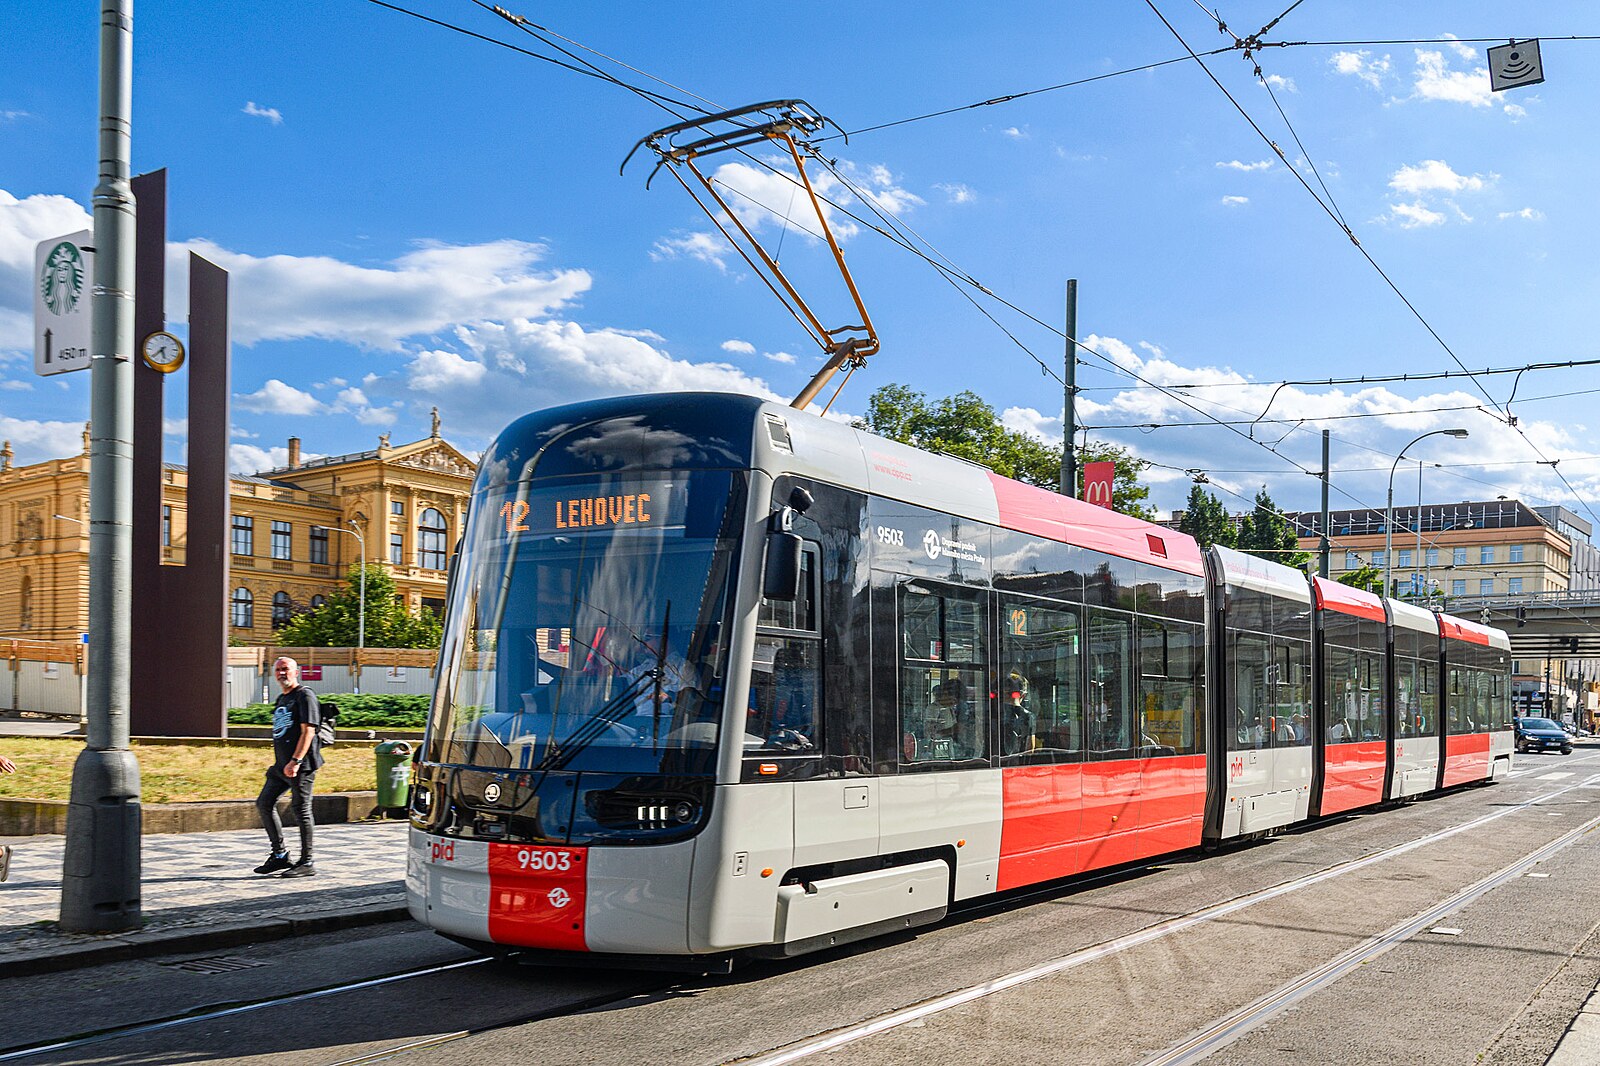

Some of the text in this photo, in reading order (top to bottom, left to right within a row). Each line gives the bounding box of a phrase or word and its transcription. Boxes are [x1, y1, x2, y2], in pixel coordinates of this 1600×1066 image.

[499, 493, 651, 533] 12 LEHOVEC
[877, 525, 904, 547] 9503
[1011, 609, 1026, 635] 12
[1230, 756, 1243, 783] pid
[432, 838, 455, 863] pid
[517, 850, 571, 871] 9503
